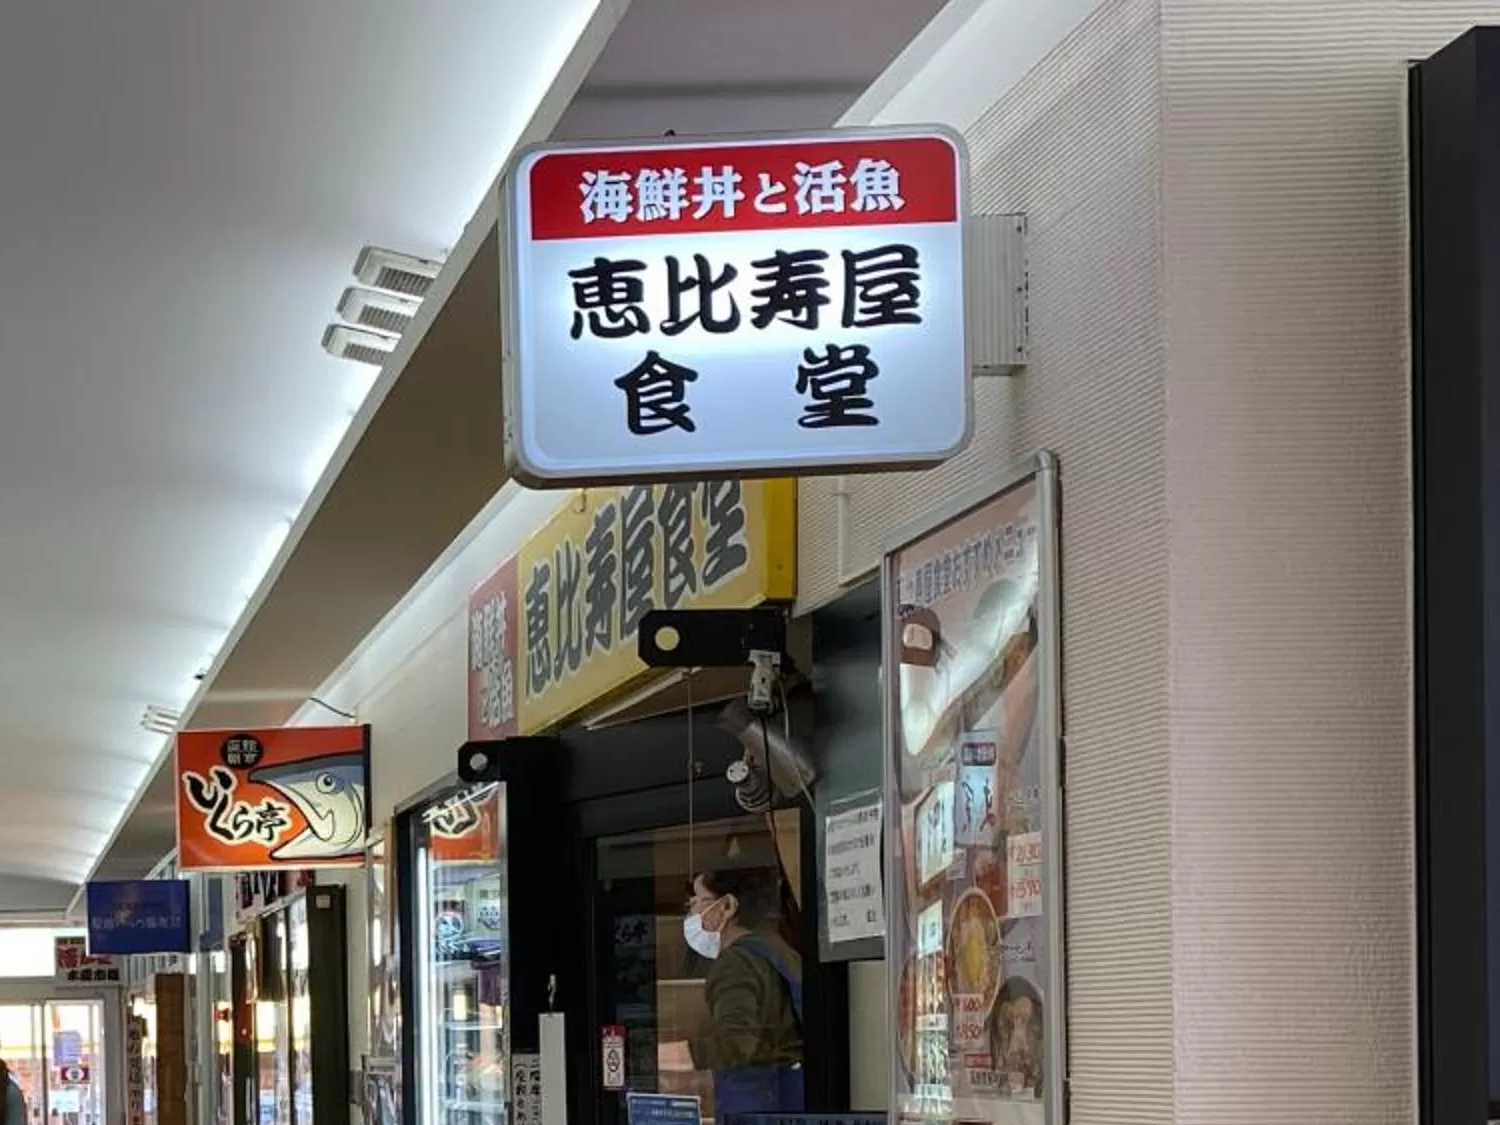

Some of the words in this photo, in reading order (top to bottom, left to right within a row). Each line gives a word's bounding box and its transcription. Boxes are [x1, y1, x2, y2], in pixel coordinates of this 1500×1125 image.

[578, 158, 905, 223] 海鮮丼と活魚
[567, 243, 922, 340] 恵比寿屋
[613, 343, 880, 436] 食堂
[185, 769, 289, 841] いくら亭
